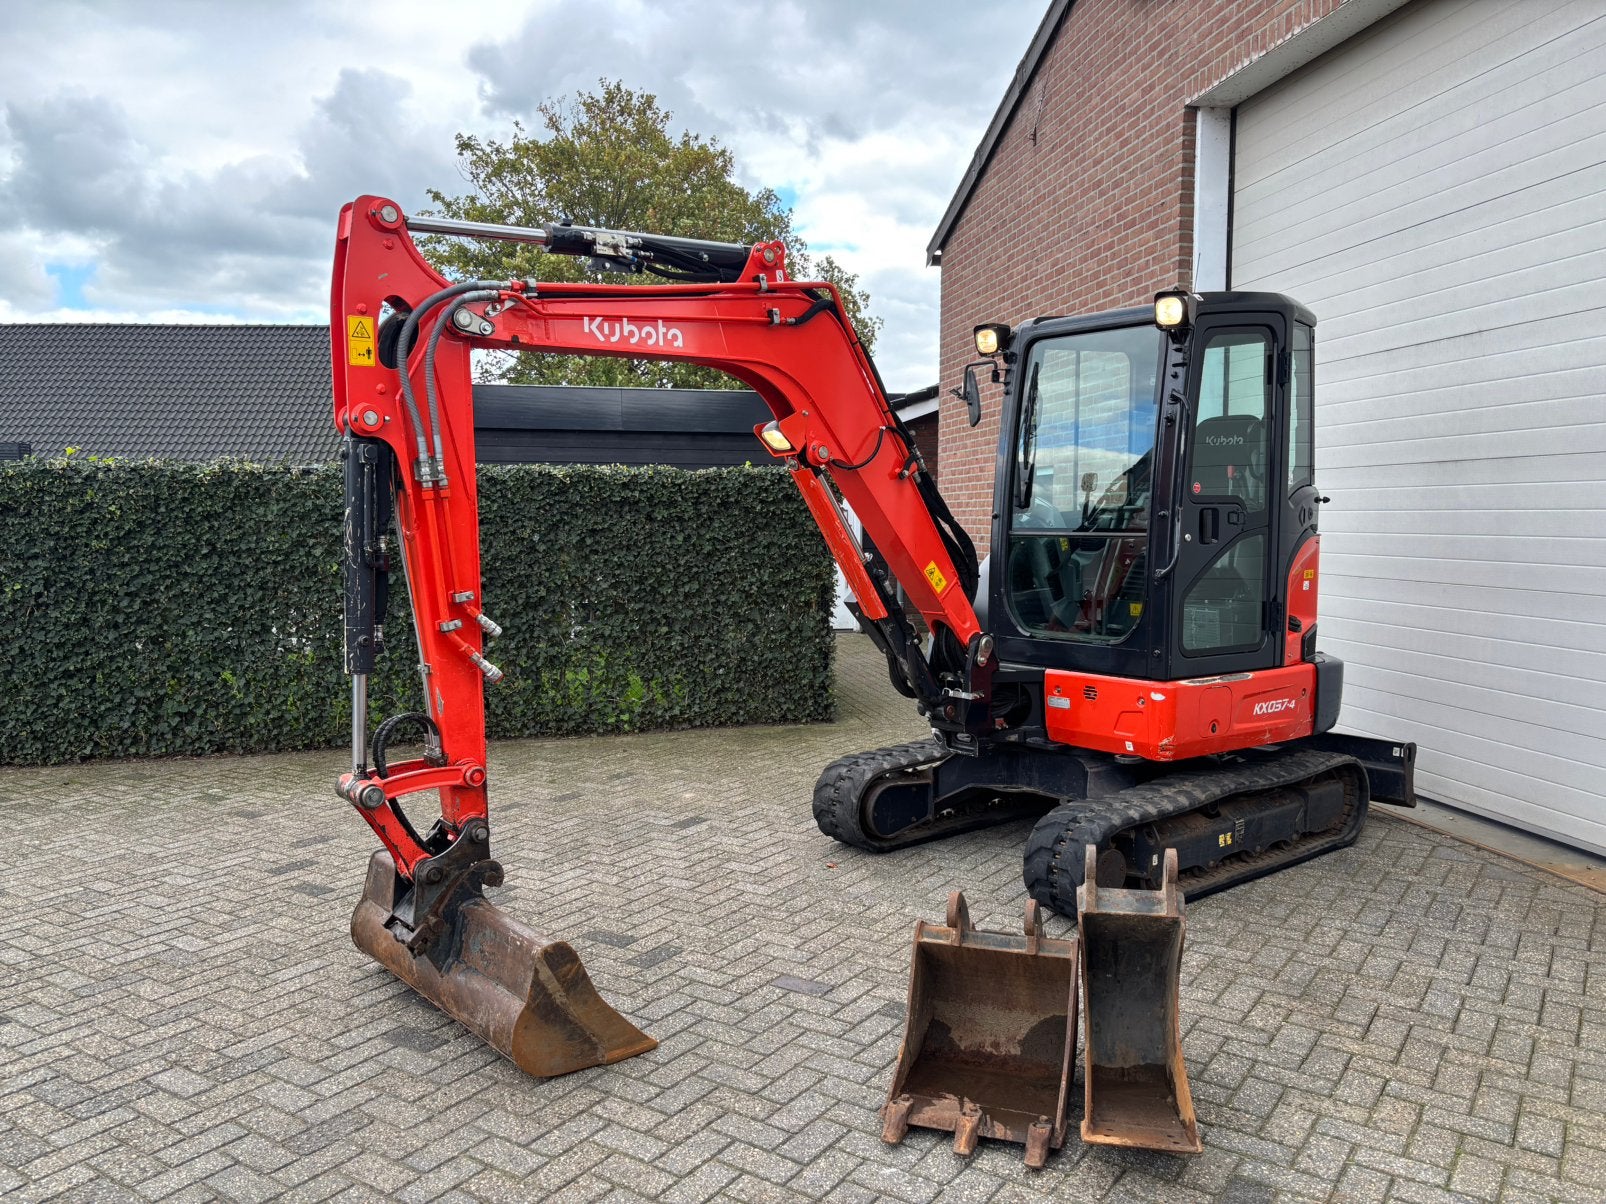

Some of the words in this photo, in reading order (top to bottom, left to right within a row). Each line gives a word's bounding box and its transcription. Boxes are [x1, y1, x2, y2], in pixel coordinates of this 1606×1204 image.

[583, 316, 683, 347] Kubota
[1205, 434, 1244, 446] Kubota
[1253, 698, 1296, 715] KX037-4
